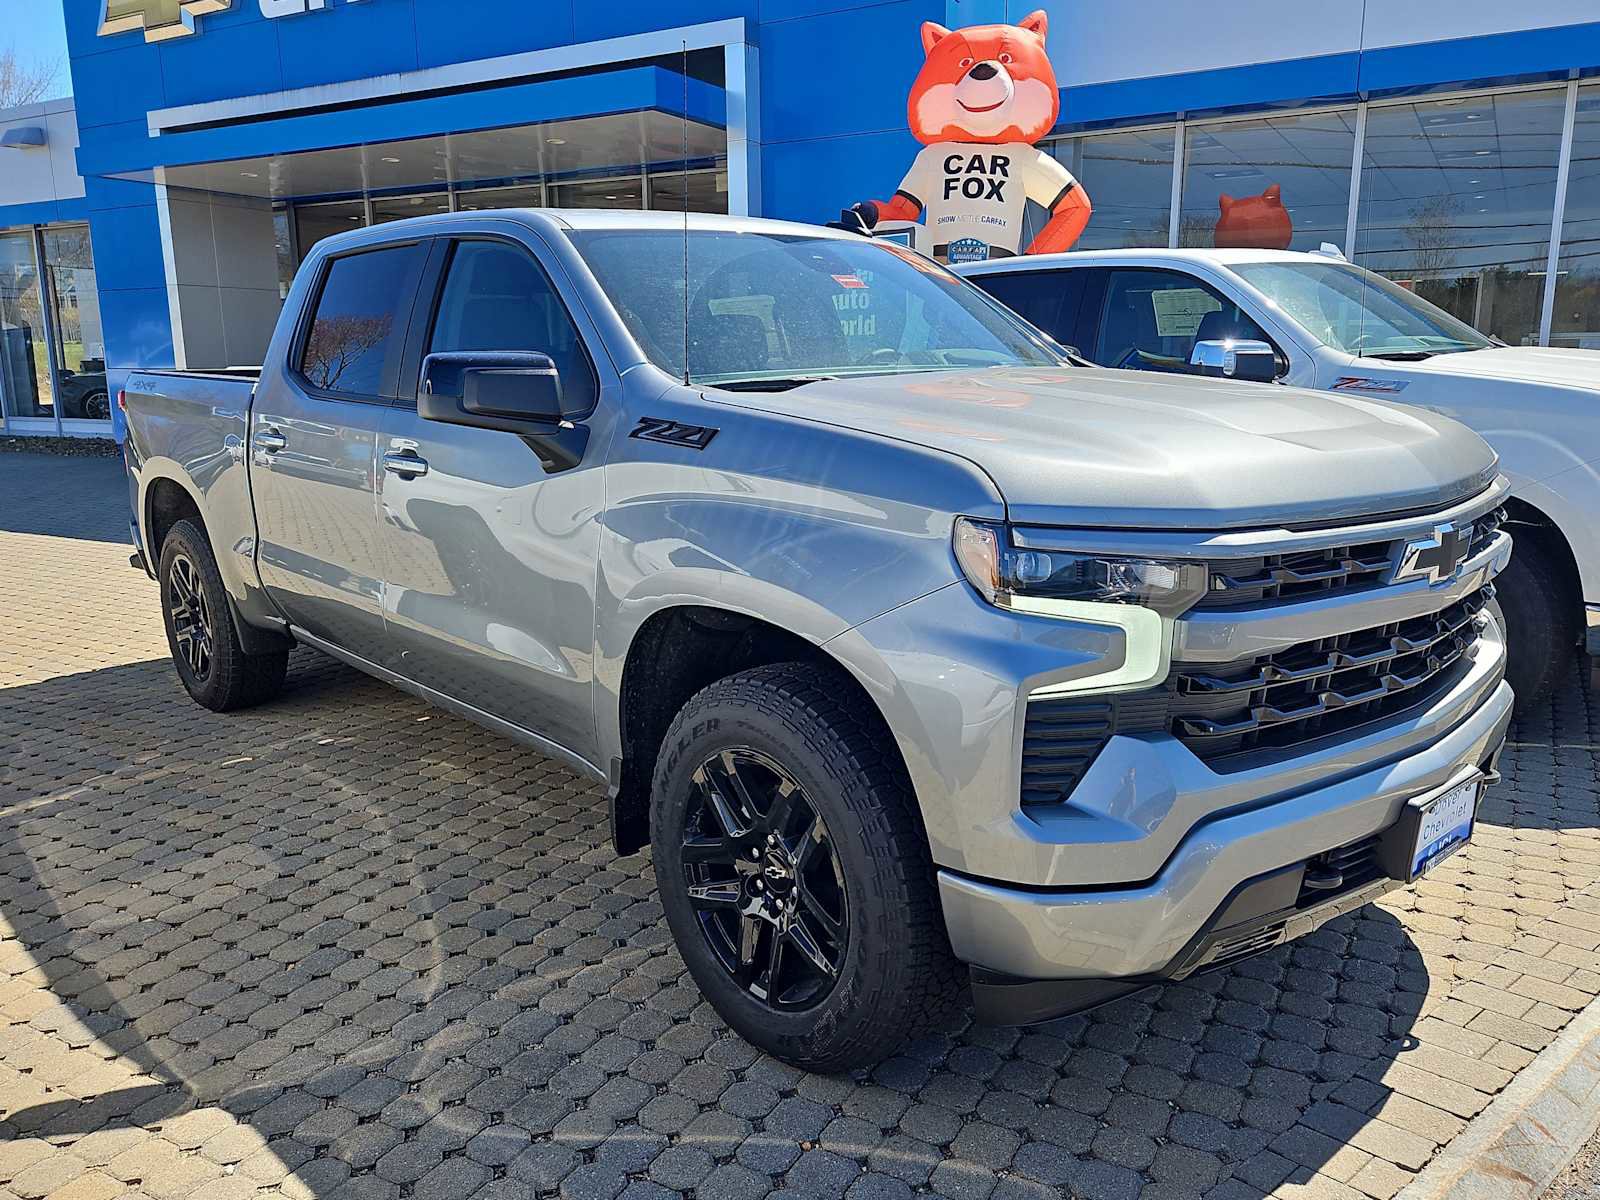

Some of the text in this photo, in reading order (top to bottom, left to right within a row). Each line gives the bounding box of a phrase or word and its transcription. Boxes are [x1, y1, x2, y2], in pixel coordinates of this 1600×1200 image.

[943, 154, 1010, 177] CAR
[943, 177, 1006, 202] FOX
[937, 215, 956, 225] SHOW
[981, 215, 1007, 227] CARFAX
[951, 246, 987, 255] CARFAX
[628, 416, 720, 451] Z71
